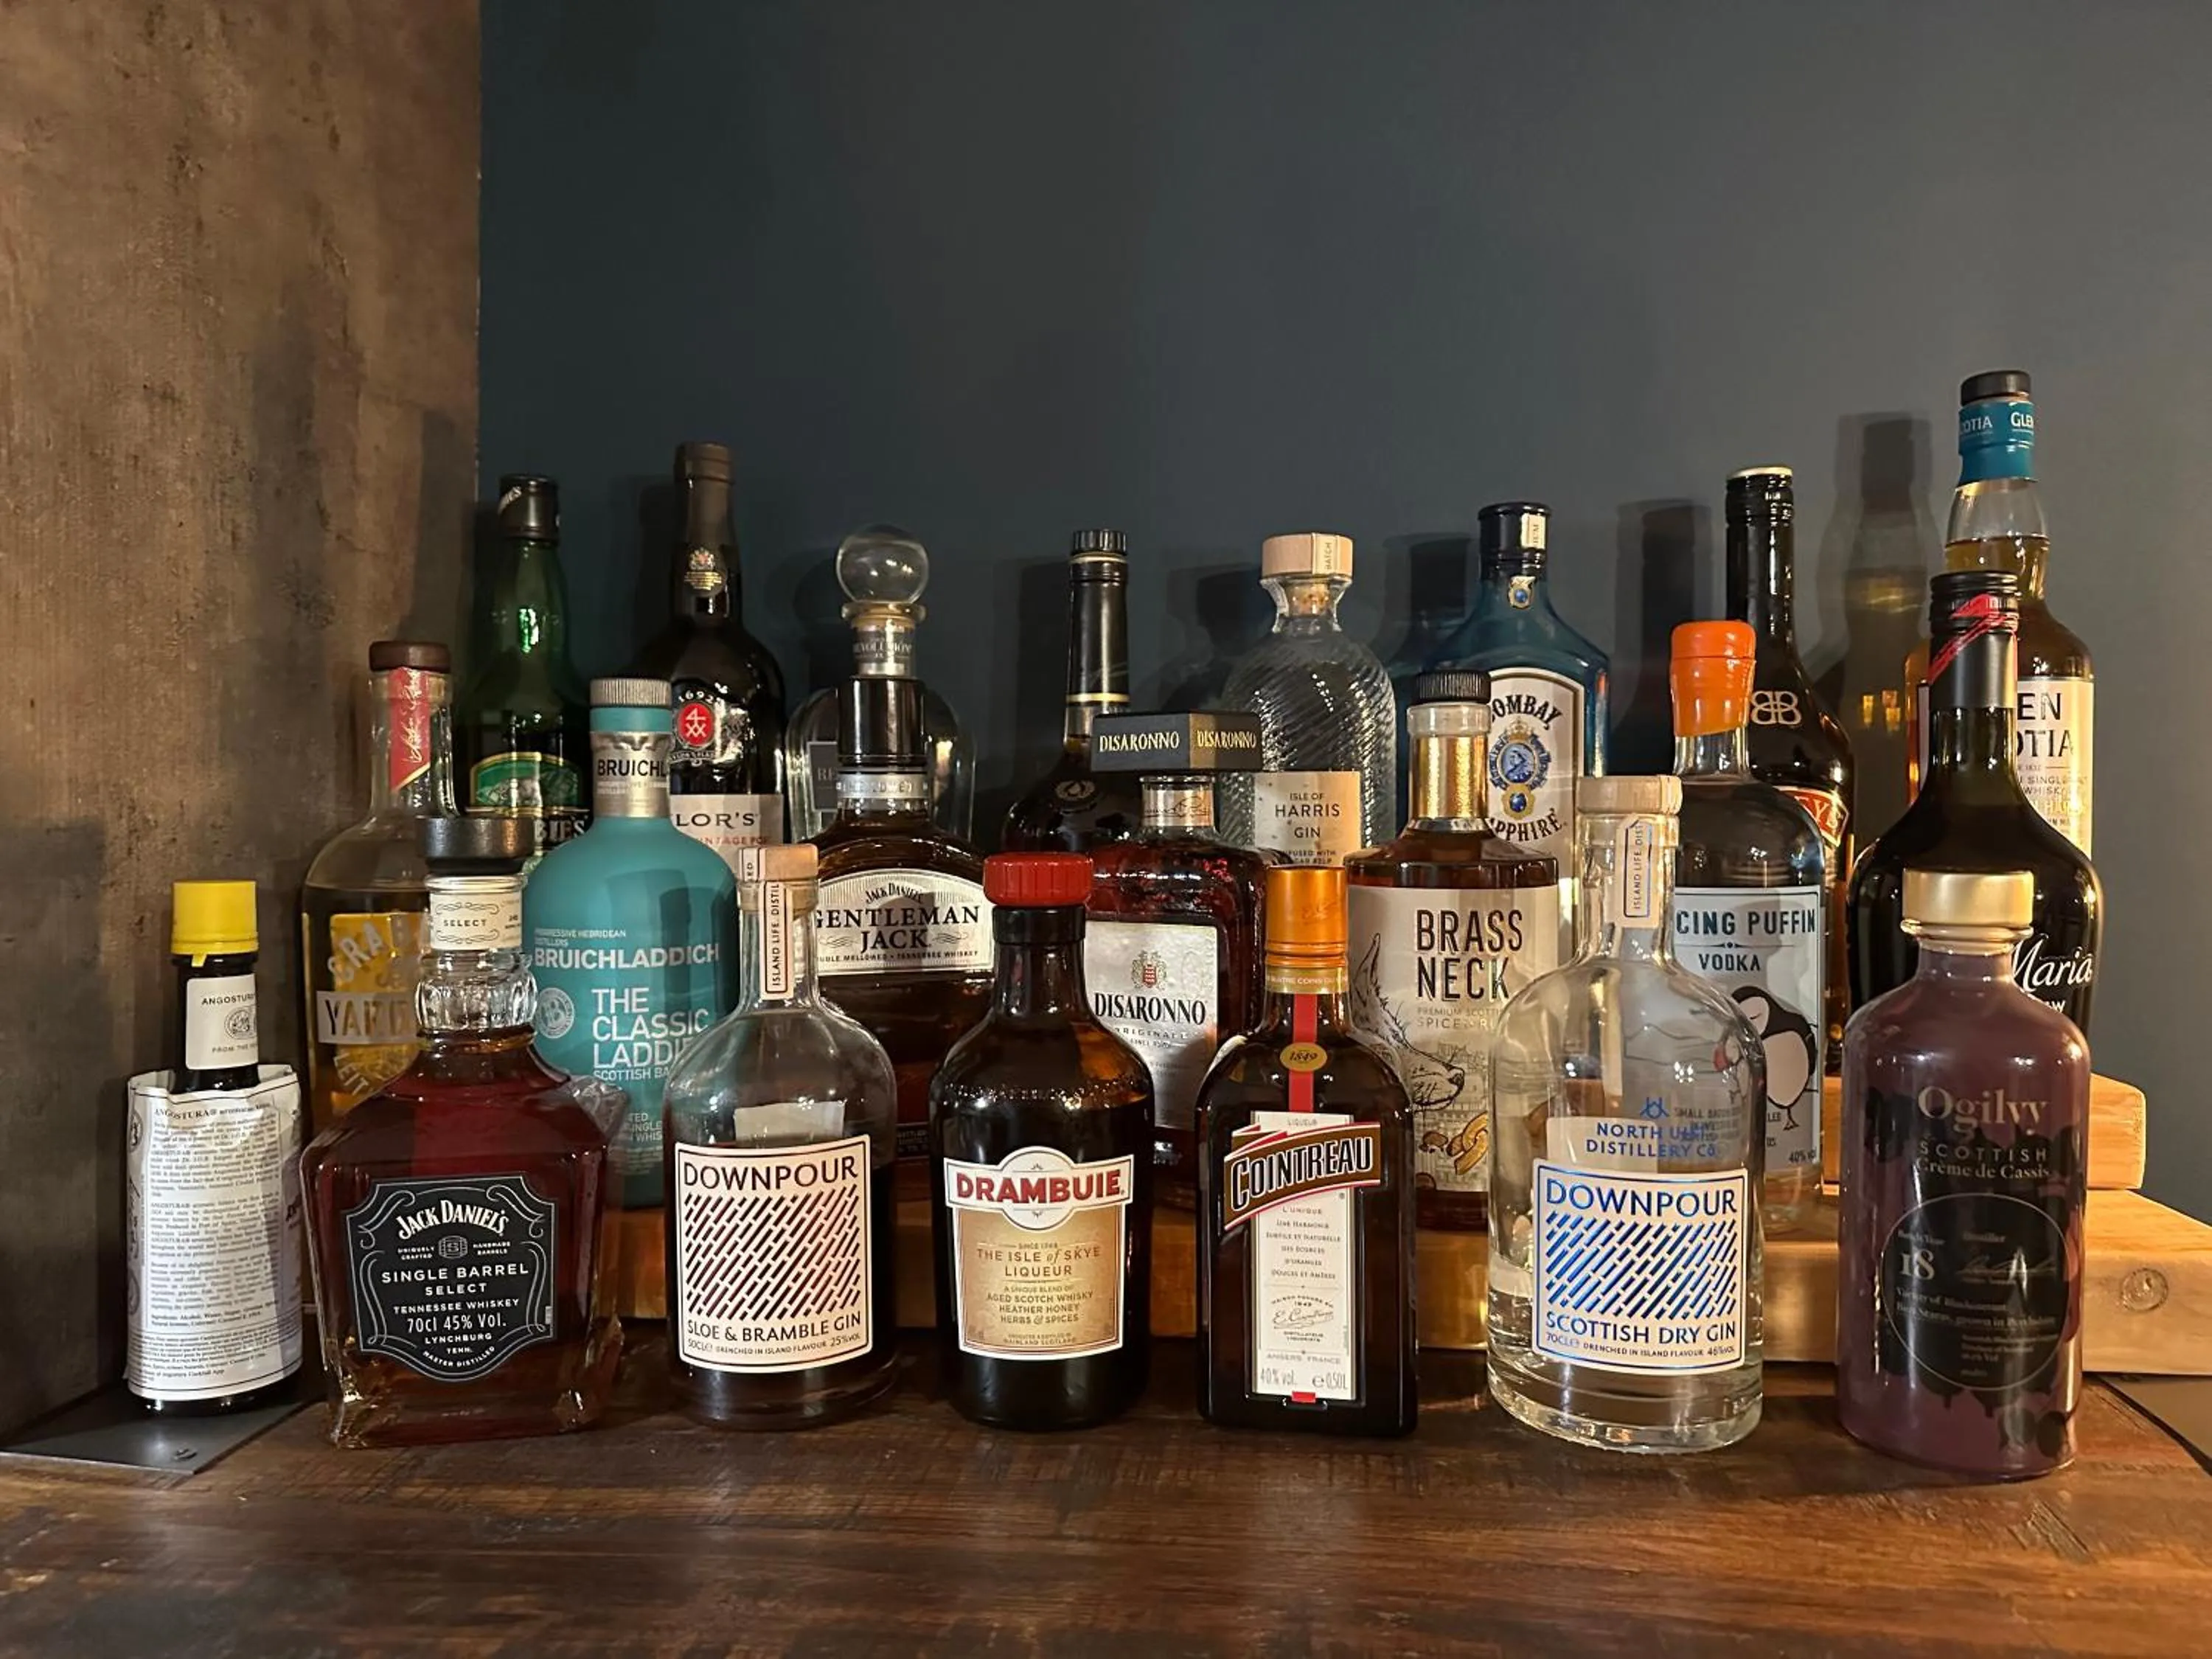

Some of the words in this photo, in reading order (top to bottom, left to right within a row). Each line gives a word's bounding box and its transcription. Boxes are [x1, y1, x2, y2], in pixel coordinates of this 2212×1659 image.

[1099, 731, 1180, 752] DISARONNO
[1197, 729, 1256, 750] DISARONNO
[1290, 793, 1309, 801] ISLE
[1311, 793, 1326, 801] OF
[1275, 803, 1341, 818] HARRIS
[1294, 827, 1321, 838] GIN
[1633, 850, 1642, 872] LIFE
[1633, 874, 1642, 910] ISLAND
[443, 919, 487, 928] SELECT
[1416, 909, 1523, 953] BRASS
[1676, 910, 1736, 936] CING
[1747, 908, 1816, 935] PUFFIN
[772, 923, 781, 945] LIFE
[860, 929, 928, 953] JACK
[535, 943, 720, 970] BRUICHLADDICH
[1698, 953, 1761, 972] VODKA
[772, 949, 781, 986] ISLAND
[1416, 956, 1510, 1001] NECK
[591, 987, 650, 1014] THE
[1093, 992, 1206, 1026] DISARONNO
[592, 1008, 709, 1042] CLASSIC
[594, 1070, 651, 1082] SCOTTISH
[1596, 1122, 1663, 1140] NORTH
[1586, 1140, 1693, 1158] DISTILLERY
[1919, 1140, 2047, 1161] SCOTTISH
[684, 1156, 858, 1191] DOWNPOUR
[1230, 1136, 1374, 1211] COINTREAU
[1975, 1161, 1996, 1178] de
[2000, 1164, 2051, 1180] Cassis
[956, 1169, 1121, 1204] DRAMBUIE
[1546, 1178, 1737, 1217] DOWNPOUR
[395, 1206, 441, 1240] JACK
[439, 1199, 510, 1235] DANIEL'S
[976, 1248, 1003, 1262] THE
[1008, 1251, 1042, 1262] ISLE
[1046, 1249, 1062, 1265] of
[1064, 1246, 1102, 1261] SKYE
[380, 1267, 448, 1284] SINGLE
[456, 1263, 529, 1279] BARREL
[1005, 1265, 1073, 1278] LIQUEUR
[425, 1282, 488, 1296] SELECT
[1015, 1295, 1054, 1304] SCOTCH
[1057, 1290, 1093, 1302] WHISKY
[392, 1301, 463, 1315] TENNESSEE
[465, 1298, 520, 1310] WHISKEY
[999, 1304, 1043, 1313] HEATHER
[1046, 1302, 1080, 1313] HONEY
[443, 1315, 473, 1332] 45%
[687, 1319, 720, 1340] SLOE
[725, 1326, 738, 1341] &
[742, 1319, 829, 1343] BRAMBLE
[834, 1310, 861, 1332] GIN
[1046, 1313, 1080, 1324] SPICES
[1546, 1310, 1649, 1343] SCOTTISH
[1659, 1326, 1702, 1344] DRY
[1706, 1321, 1736, 1342] GIN
[424, 1332, 493, 1345] LYNCHBURG
[1583, 1342, 1628, 1355] DRENCHED
[1629, 1347, 1638, 1356] IN
[1640, 1349, 1669, 1357] ISLAND
